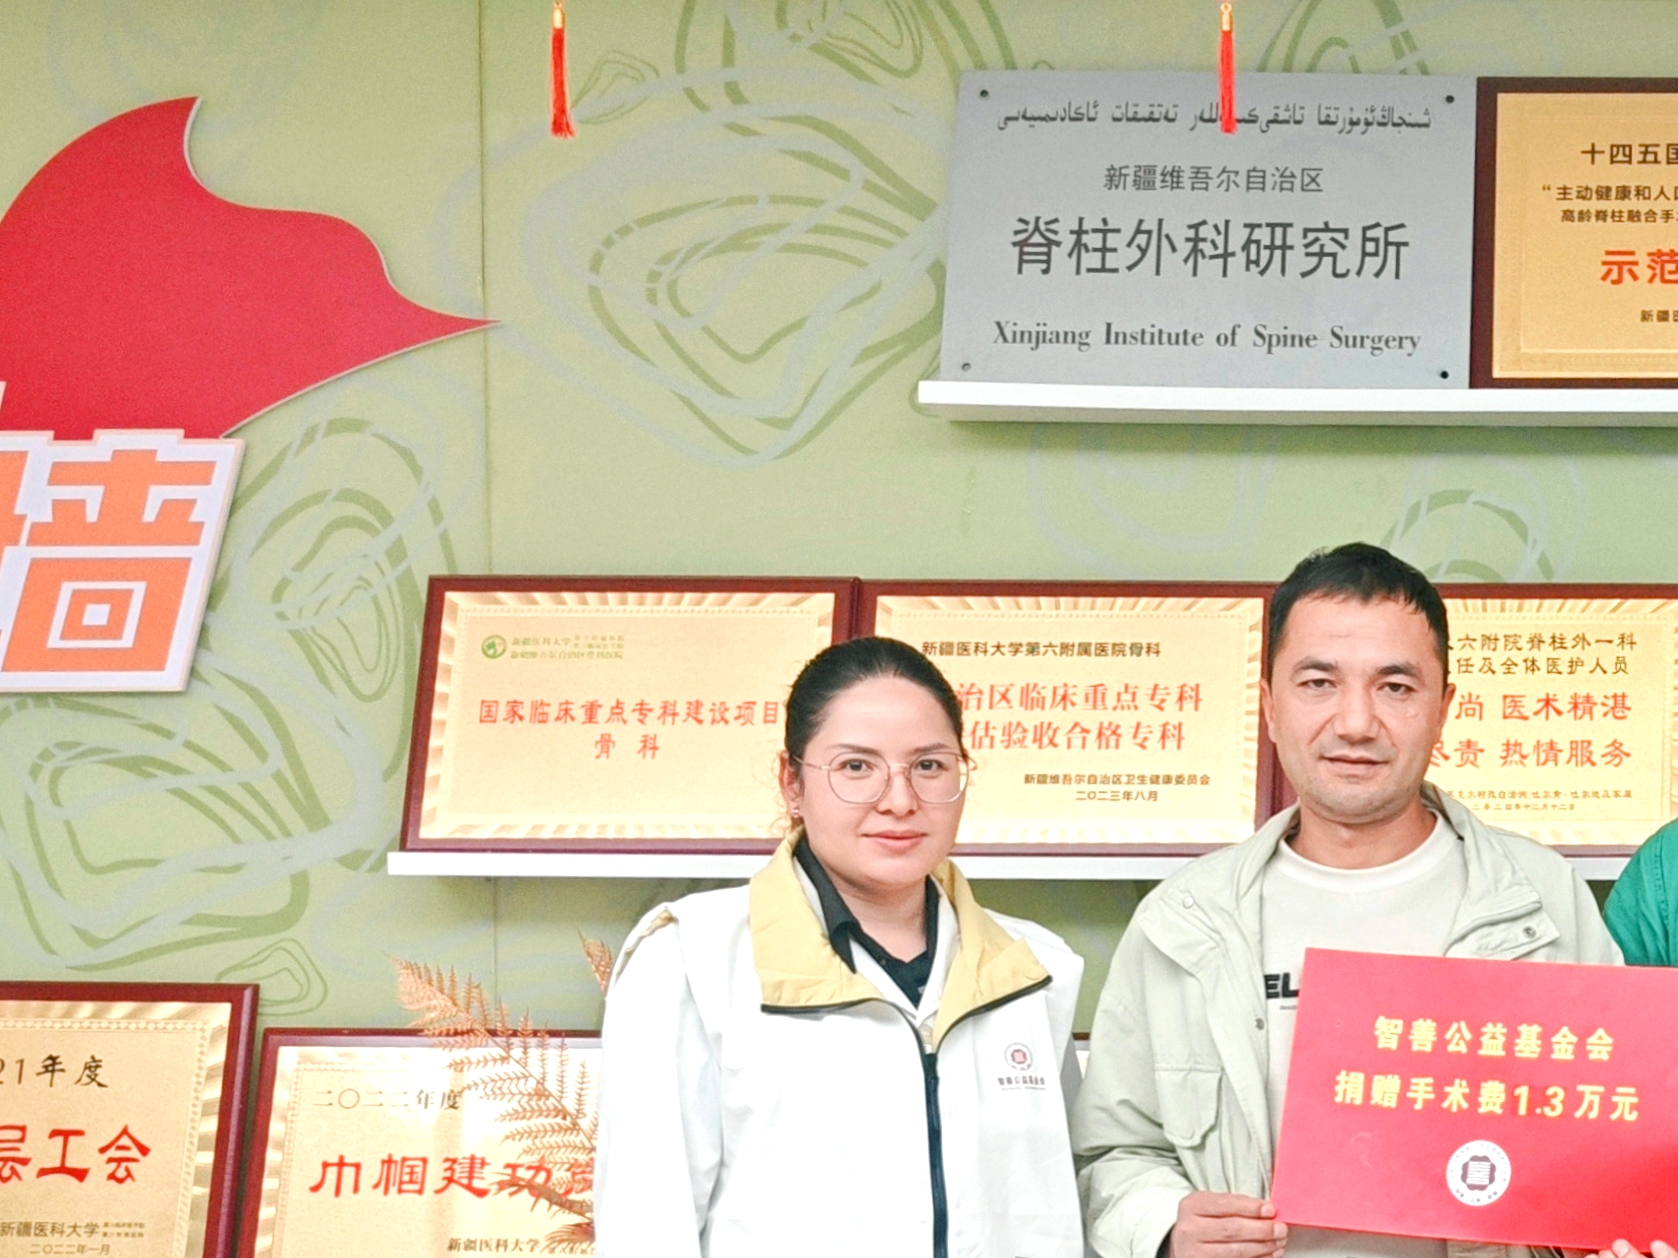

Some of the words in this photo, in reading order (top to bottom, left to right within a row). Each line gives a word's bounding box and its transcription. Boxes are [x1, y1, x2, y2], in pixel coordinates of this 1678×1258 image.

[1103, 164, 1325, 194] 新疆维吾尔自治区
[1010, 215, 1410, 280] 脊柱外科研究所
[992, 321, 1091, 351] Xinjiang
[1104, 323, 1204, 347] Institute
[1216, 324, 1239, 347] of
[1252, 325, 1318, 354] Spine
[1329, 326, 1422, 357] Surgery
[921, 641, 1162, 658] 新疆医科大学第六附属医院骨科
[1447, 632, 1638, 651] 六附院脊柱外一科
[1447, 656, 1629, 676] 任及全体医护人员
[478, 698, 780, 726] 国家临床重点专科建设项目
[1501, 691, 1632, 722] 医术精湛
[970, 721, 1186, 751] 估验收合格专科
[1498, 738, 1632, 769] 热情服务
[1023, 773, 1211, 787] 新疆维吾尔自治区卫生健康委员会
[1373, 1015, 1614, 1061] 智善公益基金会
[1333, 1069, 1641, 1122] 捐赠手术费1.3万元
